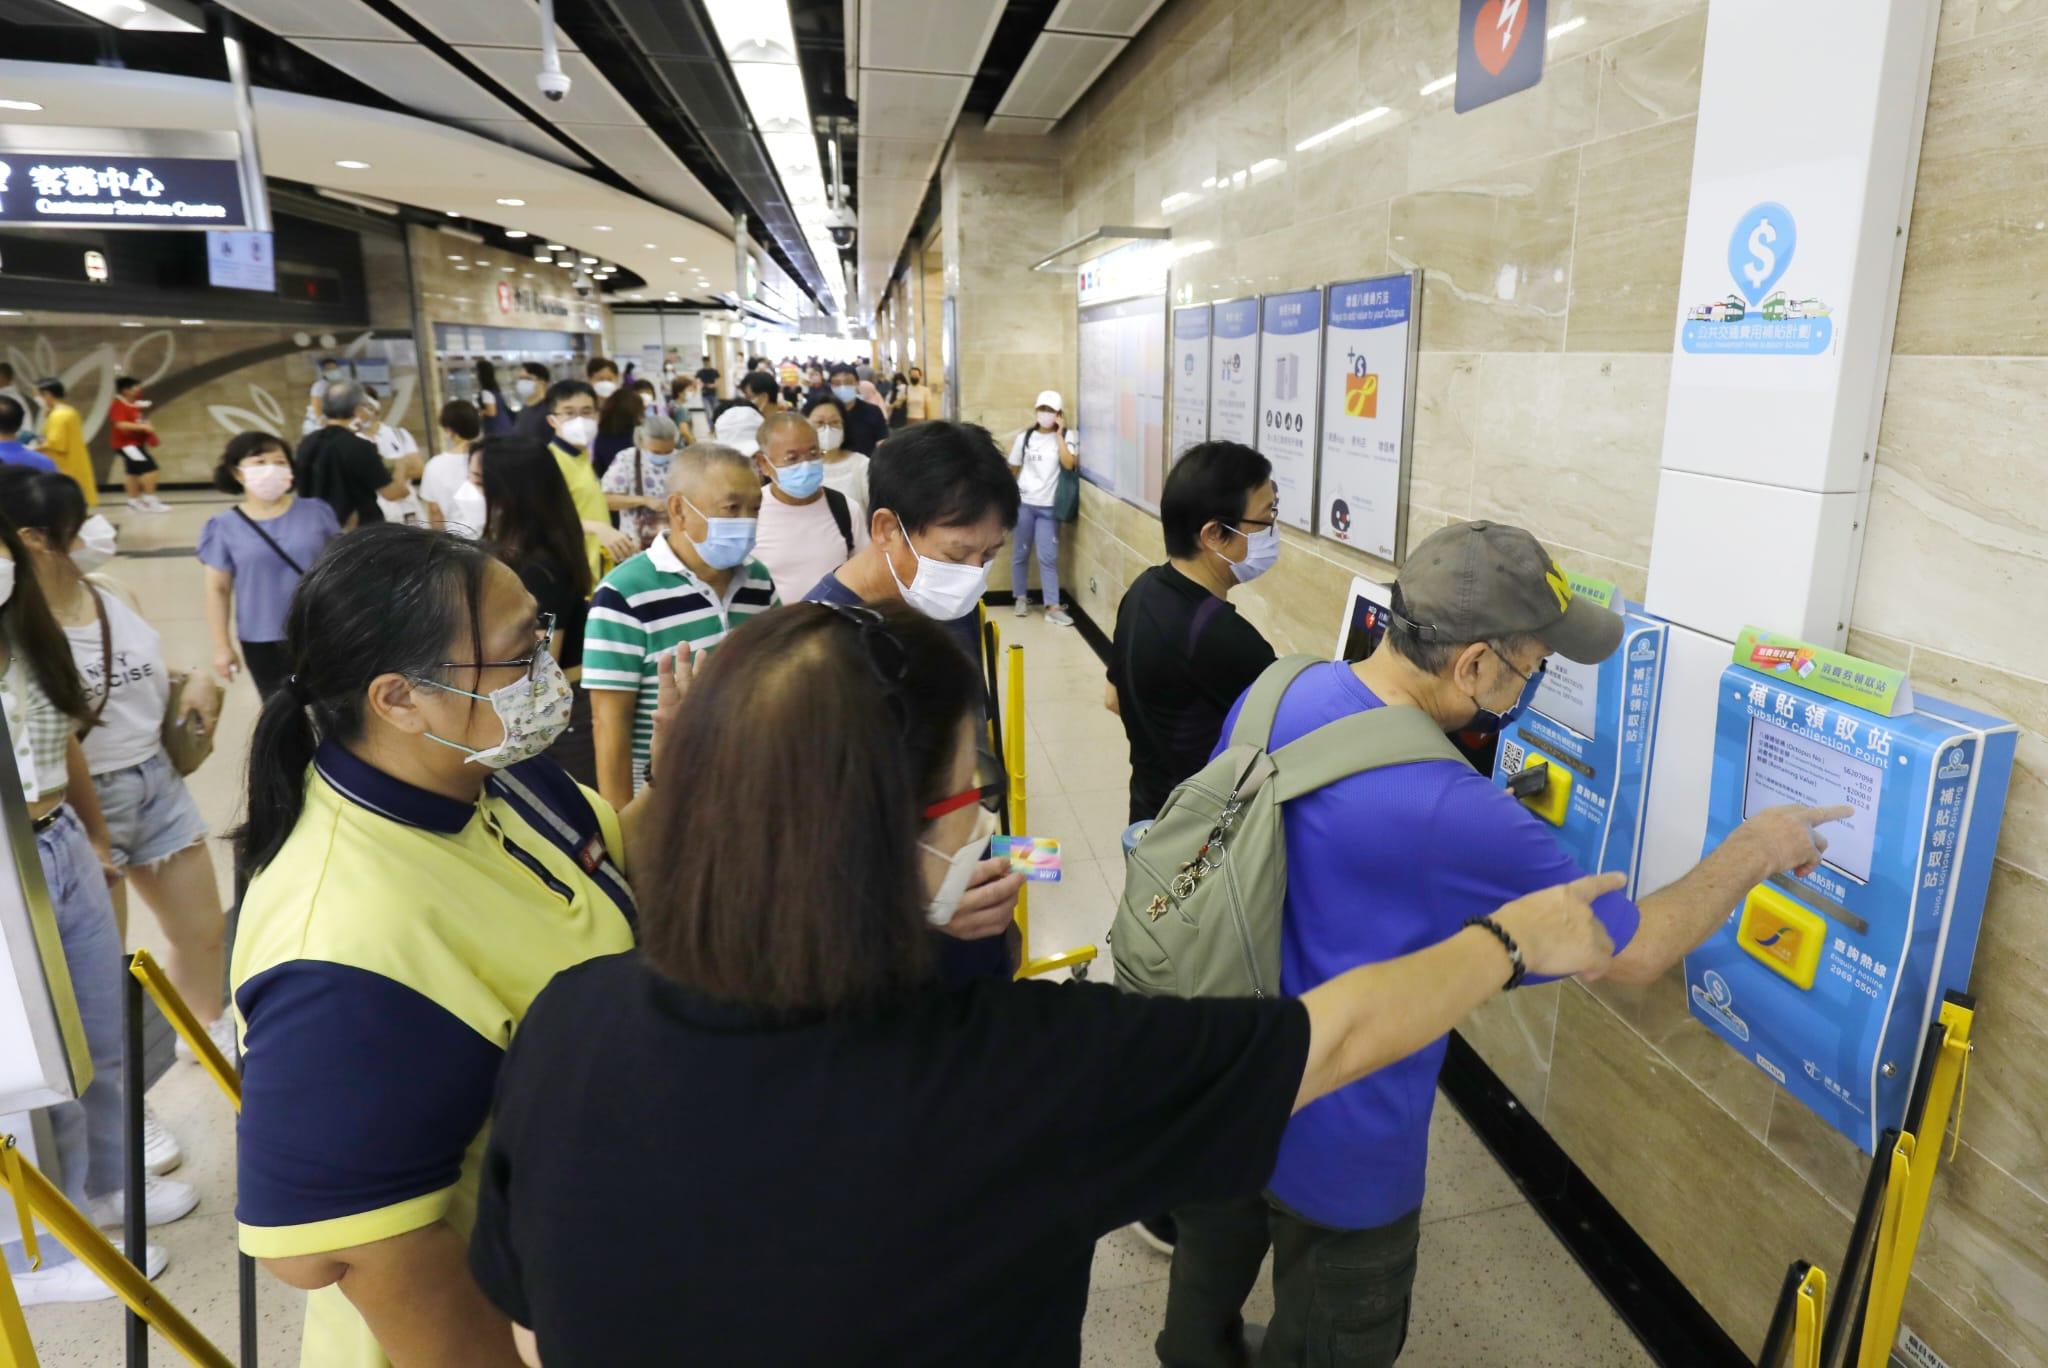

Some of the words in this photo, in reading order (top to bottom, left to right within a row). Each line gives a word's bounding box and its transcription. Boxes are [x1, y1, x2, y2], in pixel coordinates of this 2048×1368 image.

[29, 164, 165, 197] 客務中心
[1746, 704, 1788, 730] Subsidy
[1791, 721, 1851, 753] Collection
[1855, 746, 1889, 769] Point
[1748, 682, 1893, 757] 補貼領取站
[1949, 786, 1964, 829] Subsidy
[1923, 787, 1956, 889] 補貼領取站
[1937, 831, 1956, 888] Collection
[1830, 953, 1857, 973] Enquiry
[1858, 969, 1883, 990] hotline
[1833, 937, 1888, 979] 查詢熱線
[1854, 978, 1878, 998] 5500
